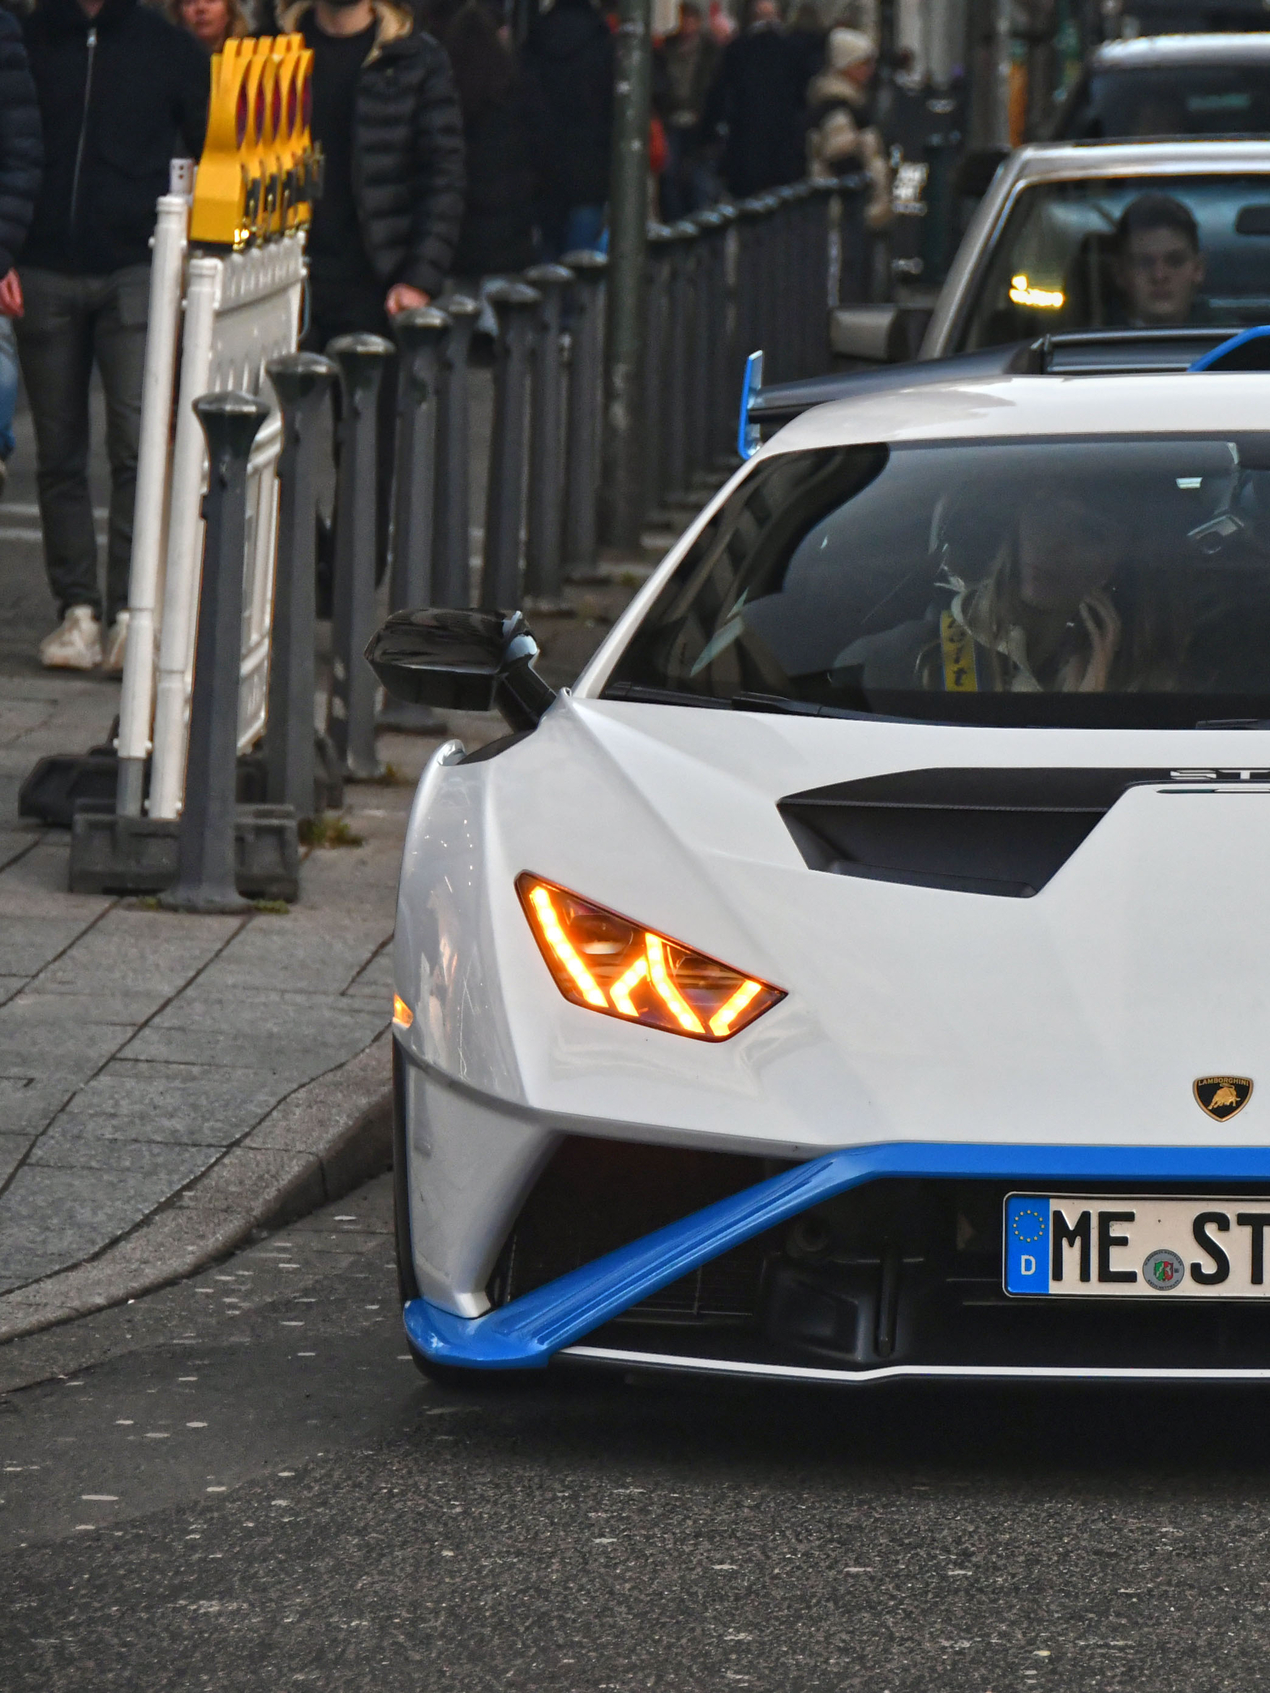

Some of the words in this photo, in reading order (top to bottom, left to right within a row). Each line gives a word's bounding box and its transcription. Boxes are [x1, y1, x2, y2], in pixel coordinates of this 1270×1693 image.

[1198, 1078, 1249, 1086] LAMBORGHINI
[1052, 1210, 1138, 1282] ME
[1020, 1254, 1036, 1276] D
